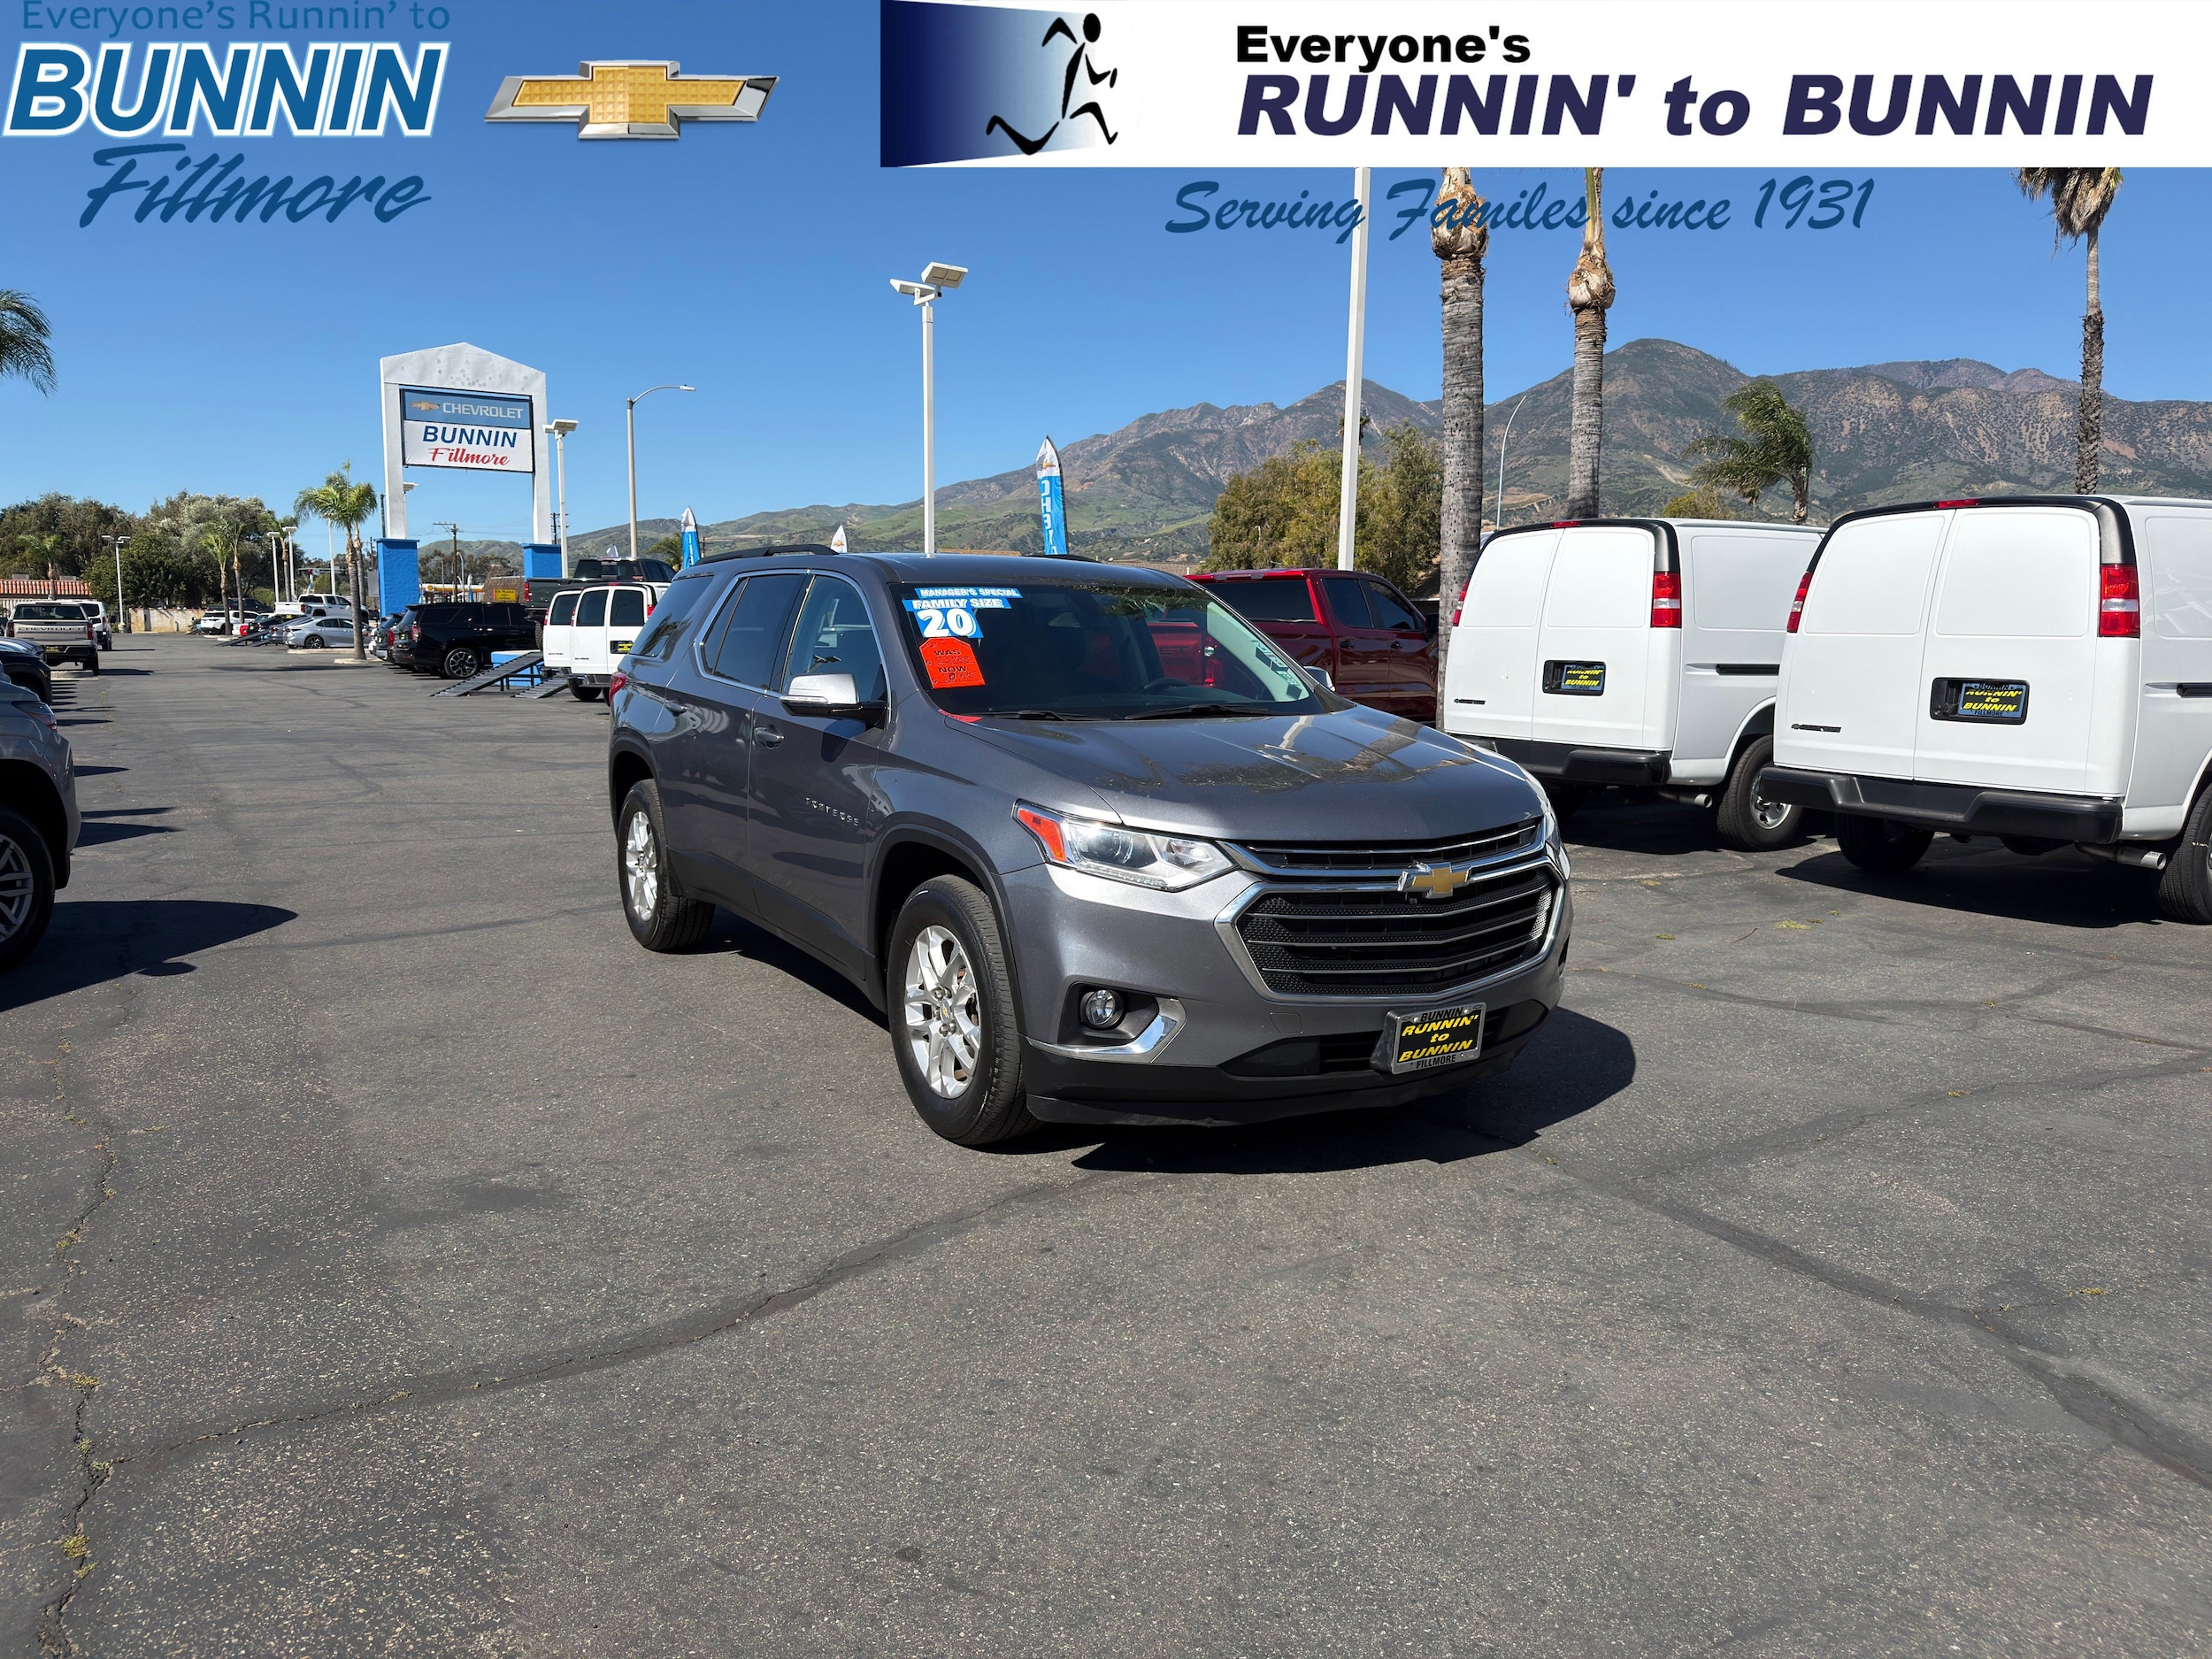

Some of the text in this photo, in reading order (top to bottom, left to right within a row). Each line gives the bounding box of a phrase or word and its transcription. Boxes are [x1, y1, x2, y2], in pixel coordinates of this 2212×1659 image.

[442, 402, 524, 419] CHEVROLET
[422, 425, 518, 448] BUNNIN
[427, 447, 511, 466] Fillmore
[920, 588, 1020, 597] MANAGER'S SPECIAL
[911, 597, 1005, 610] FAMILY SIZE
[916, 608, 977, 637] 20
[1962, 702, 2017, 711] BUNNIN
[1420, 1007, 1464, 1022] BUNNIN
[1401, 1014, 1479, 1037] RUNNIN'
[1430, 1033, 1450, 1043] to
[1398, 1039, 1473, 1063] BUNNIN
[1416, 1054, 1456, 1069] FILLMORE
